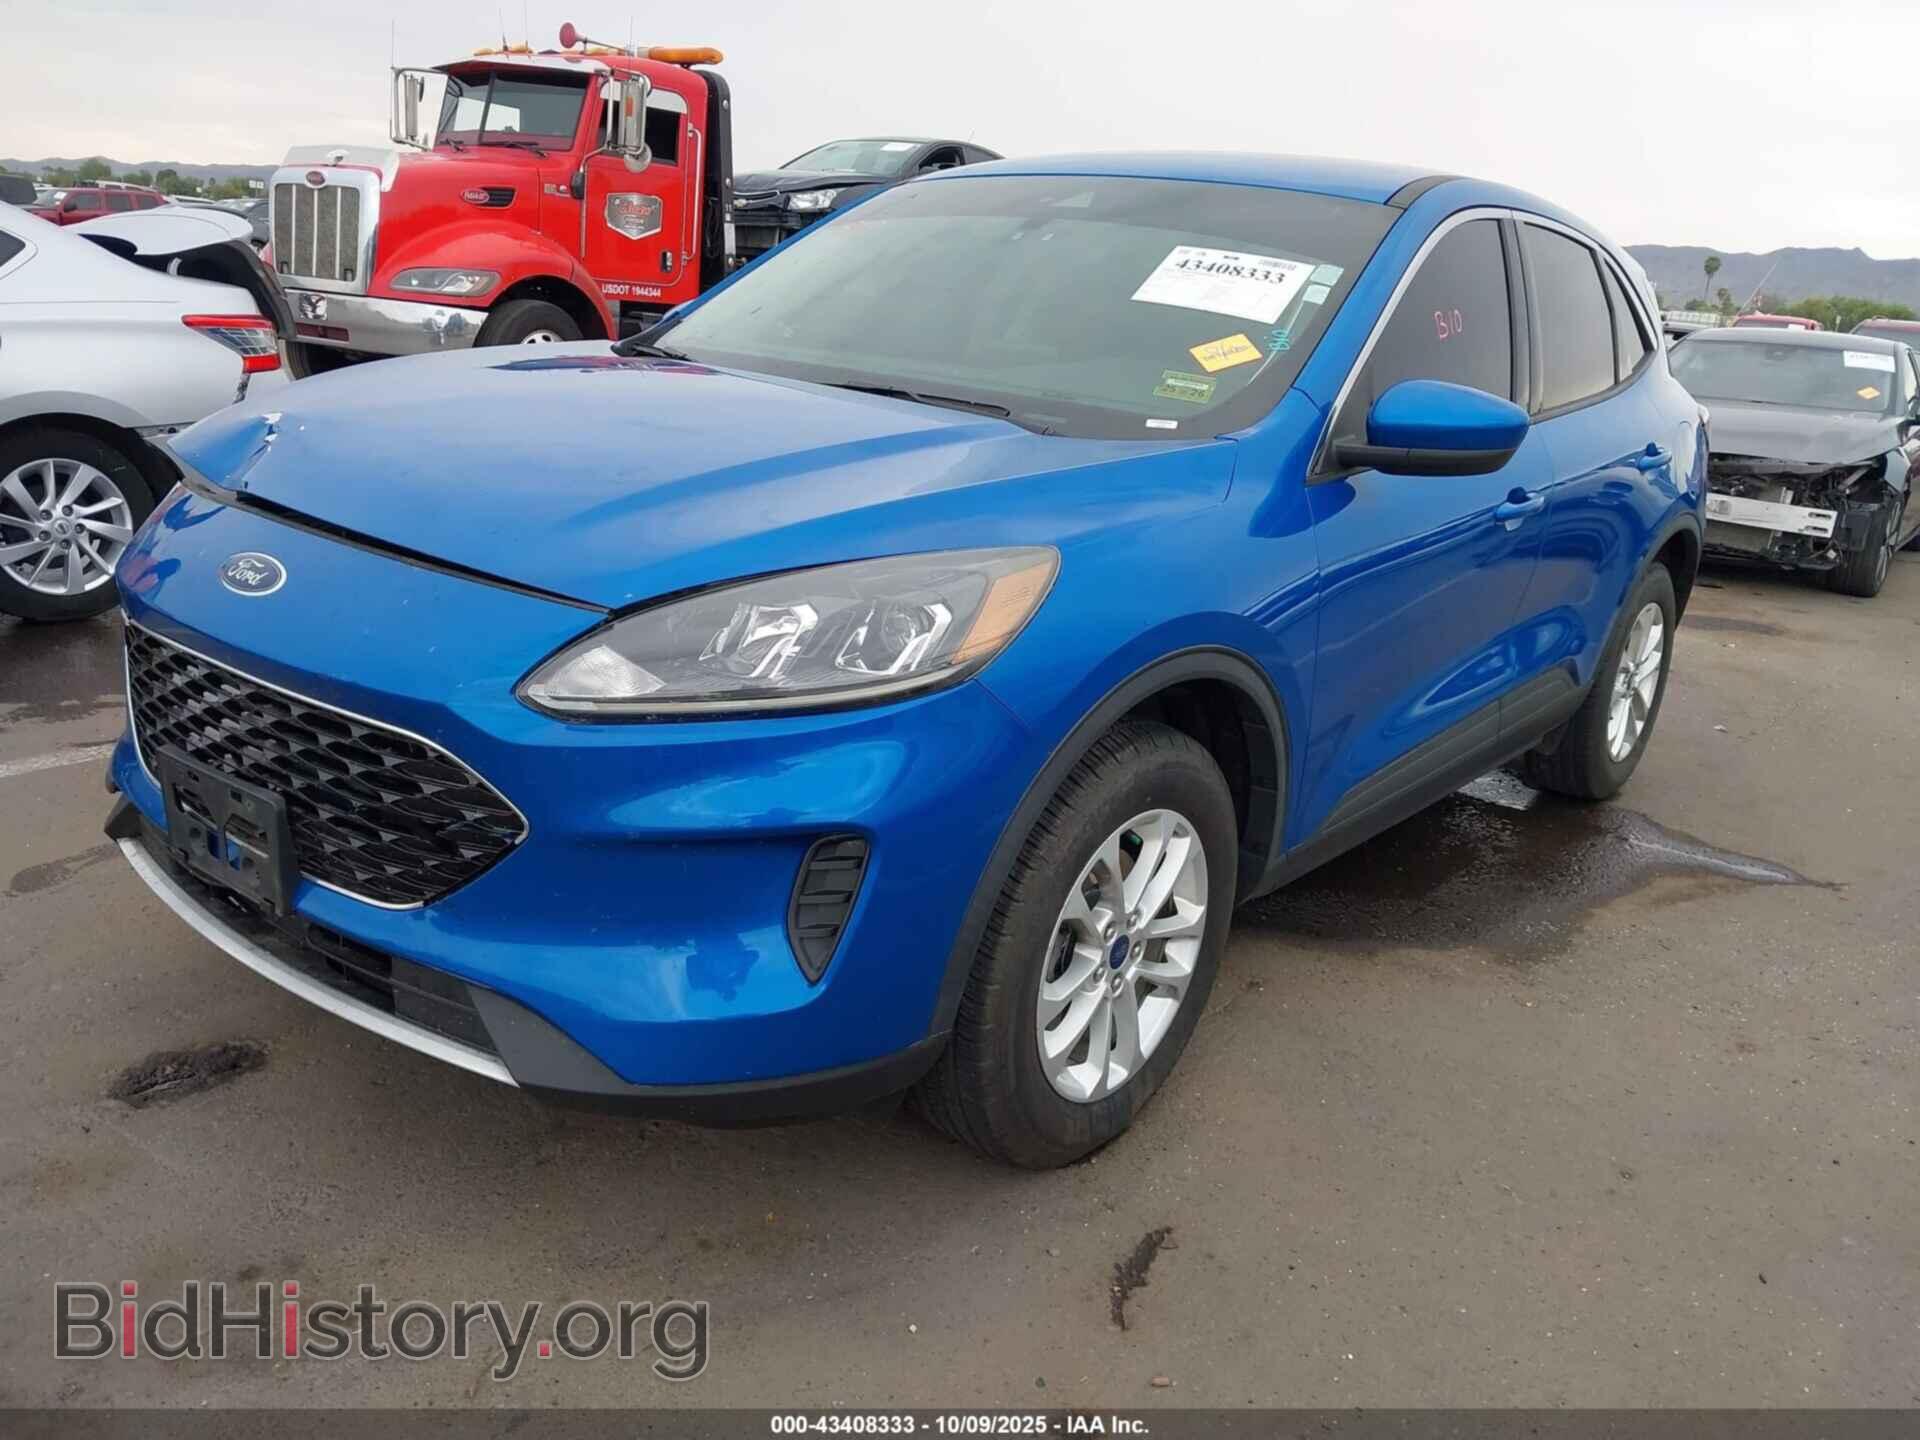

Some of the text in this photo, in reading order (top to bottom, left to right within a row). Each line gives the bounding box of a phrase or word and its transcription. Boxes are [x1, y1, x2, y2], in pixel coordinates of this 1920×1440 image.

[1175, 258, 1286, 285] 43408333
[602, 283, 629, 296] USDOT
[1434, 309, 1462, 339] B10
